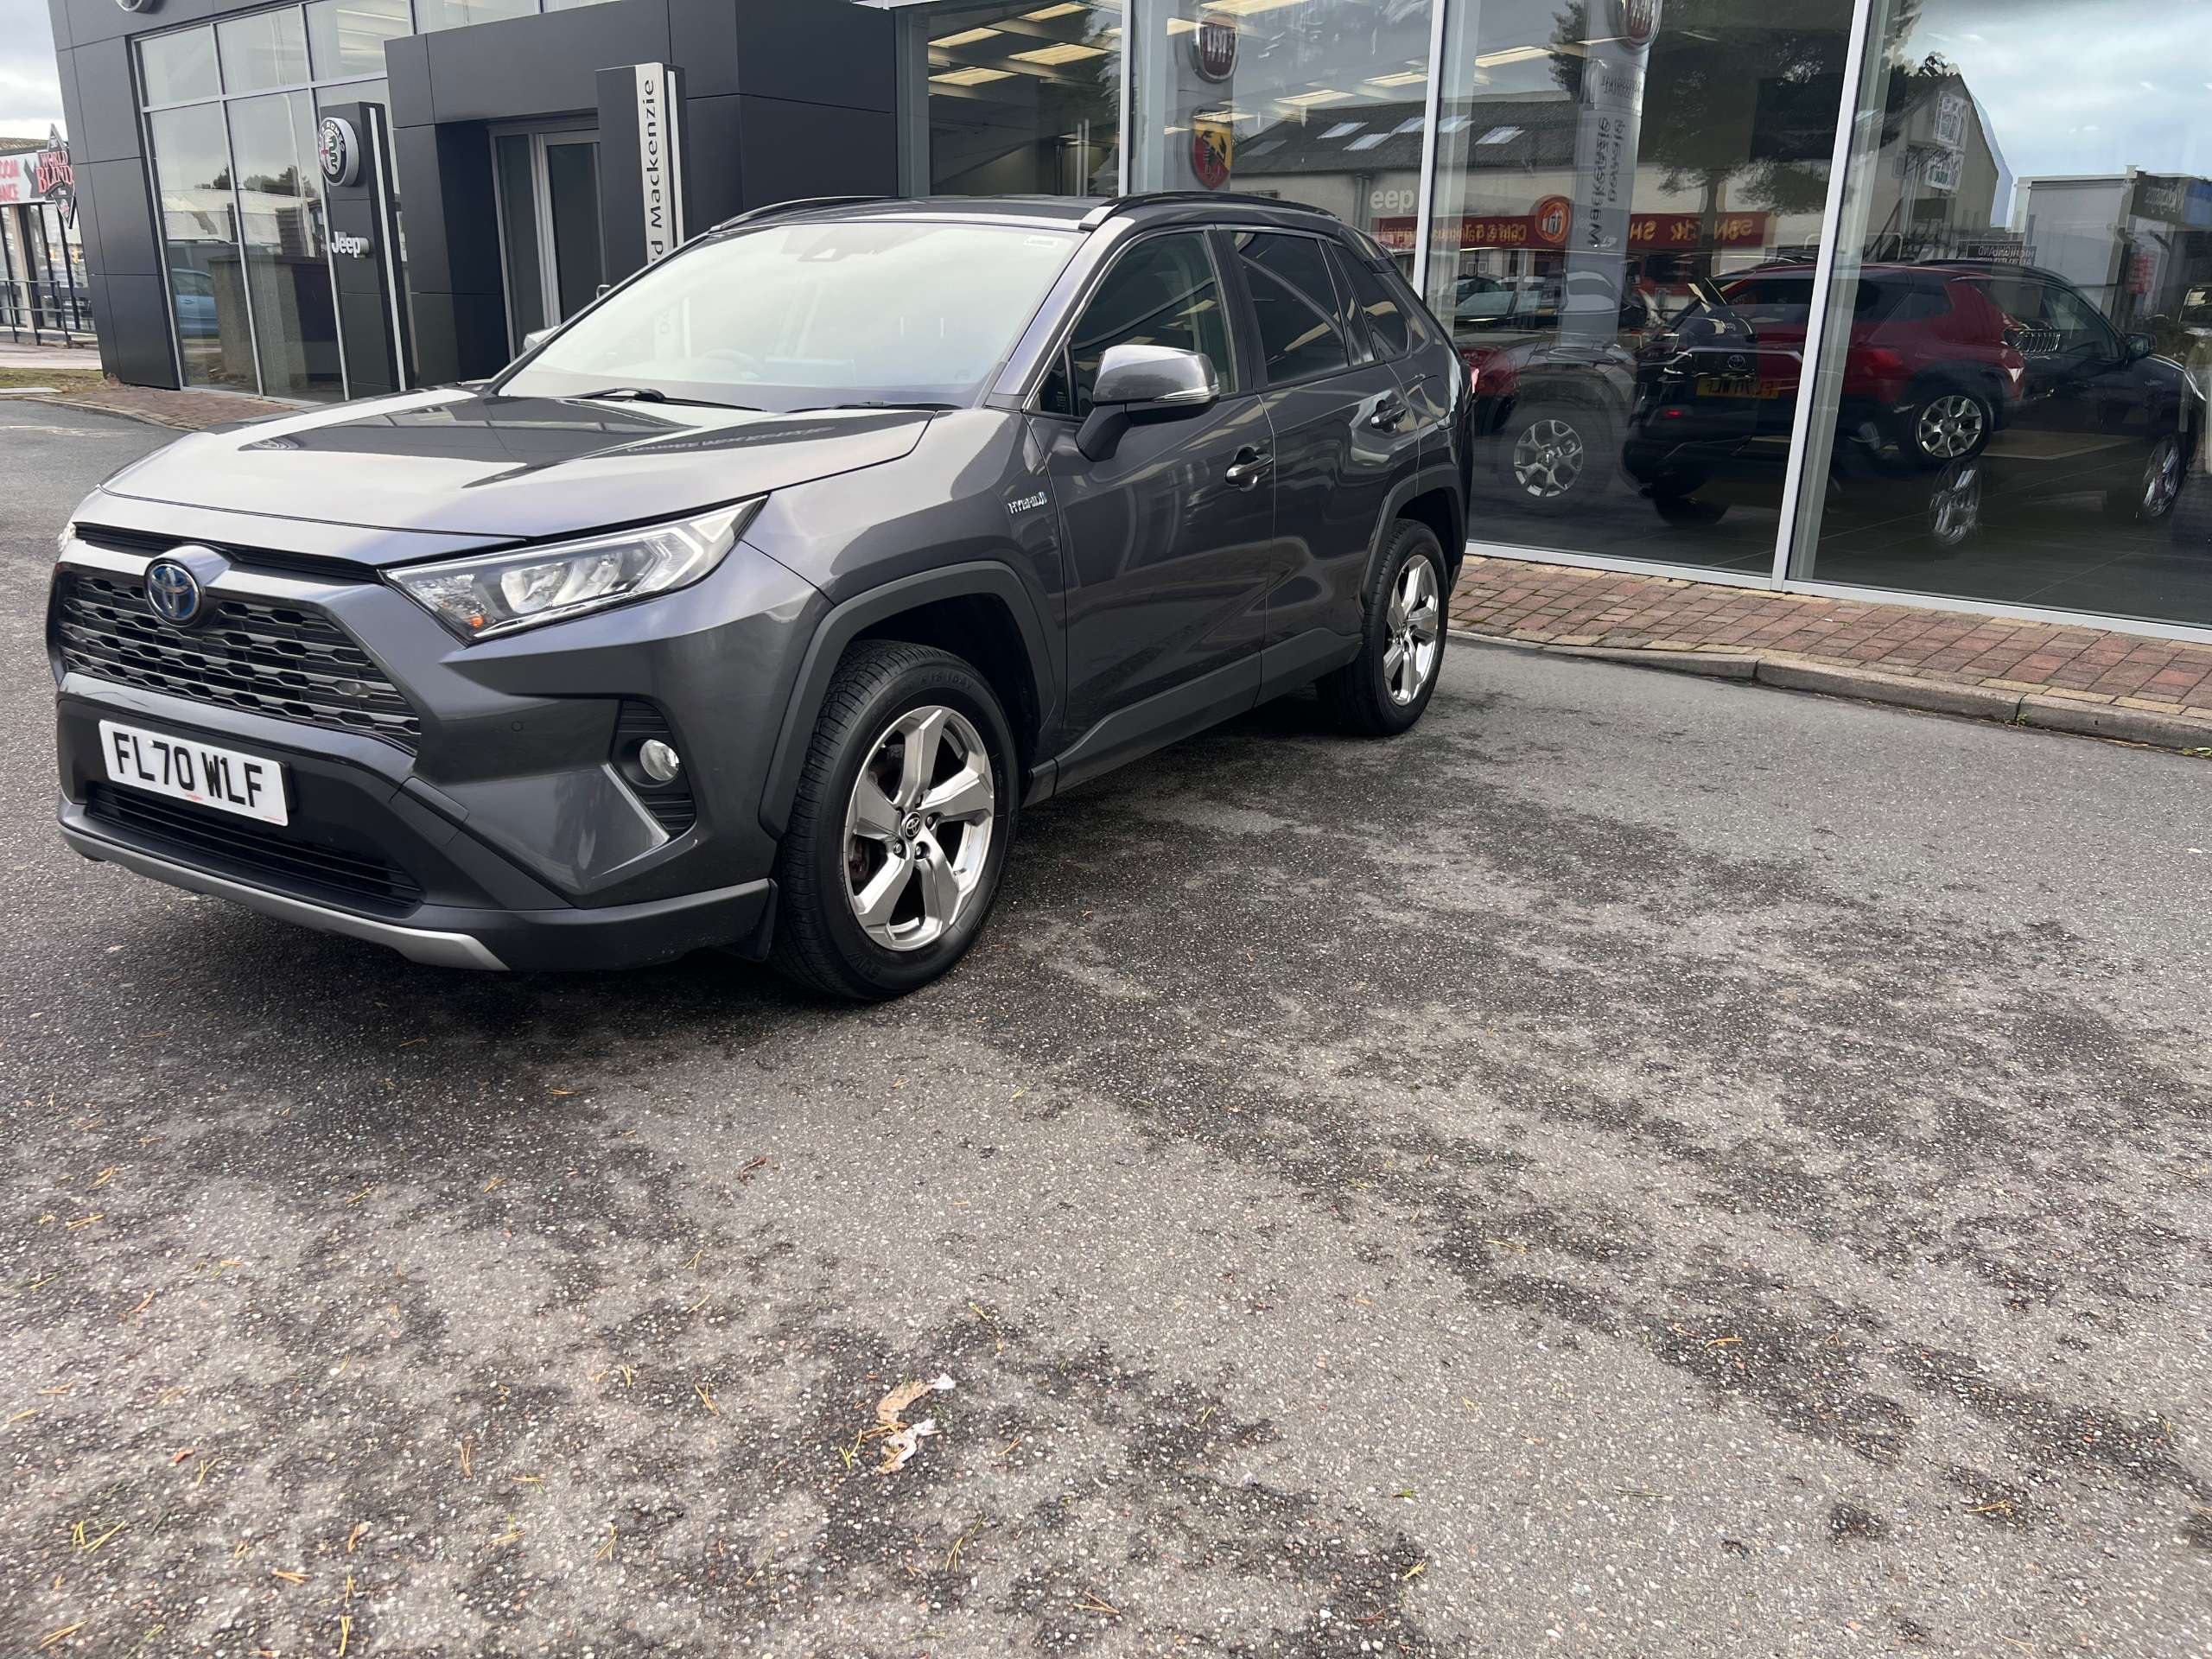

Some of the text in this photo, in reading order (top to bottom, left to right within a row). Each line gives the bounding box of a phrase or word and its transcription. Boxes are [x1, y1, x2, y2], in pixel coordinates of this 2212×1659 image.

[41, 150, 69, 168] WORLD
[642, 79, 664, 229] Mackenzie
[331, 231, 361, 258] Jeep
[1007, 491, 1048, 515] HYBRID
[112, 732, 263, 808] FL70 WLF
